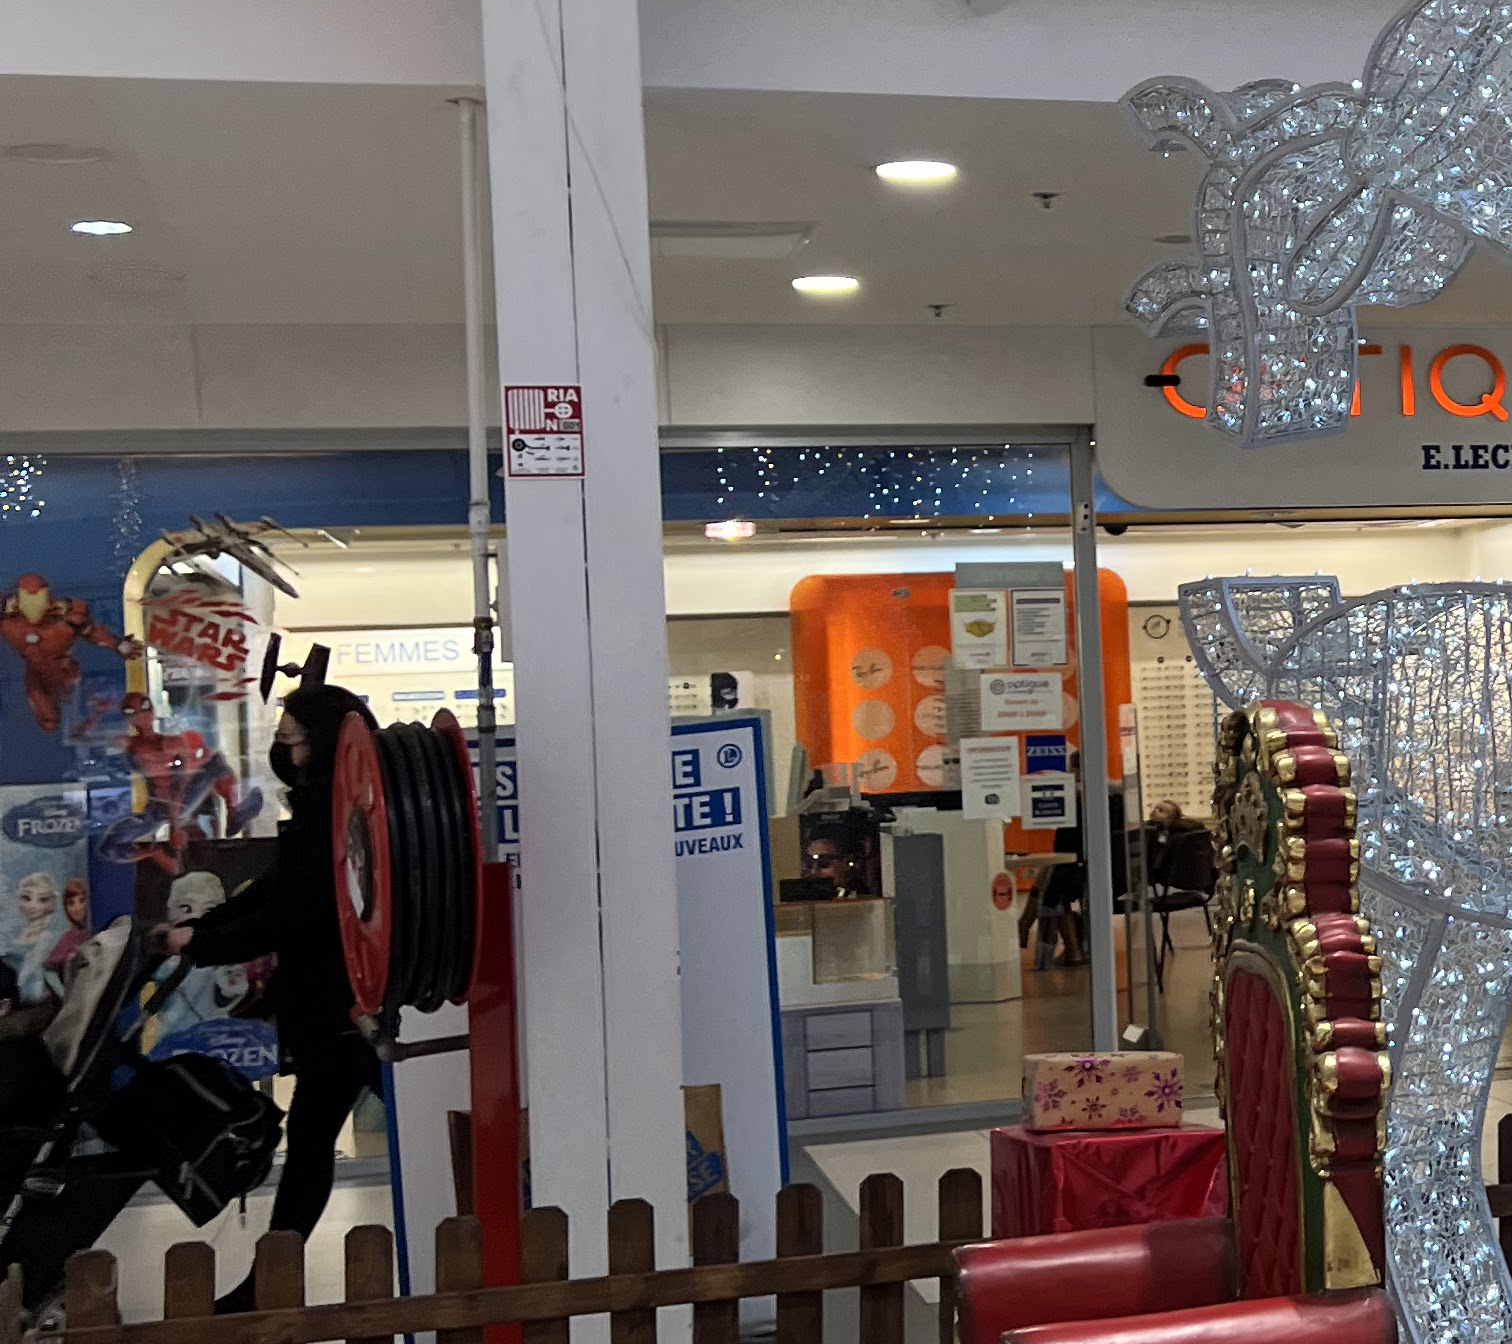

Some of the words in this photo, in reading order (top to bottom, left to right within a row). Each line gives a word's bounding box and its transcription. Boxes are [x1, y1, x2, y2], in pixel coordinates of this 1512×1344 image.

[547, 388, 579, 402] RIA
[151, 609, 250, 655] STAR
[148, 623, 246, 672] WARS
[337, 640, 460, 665] FEMMES
[1027, 745, 1066, 757] ZEISS
